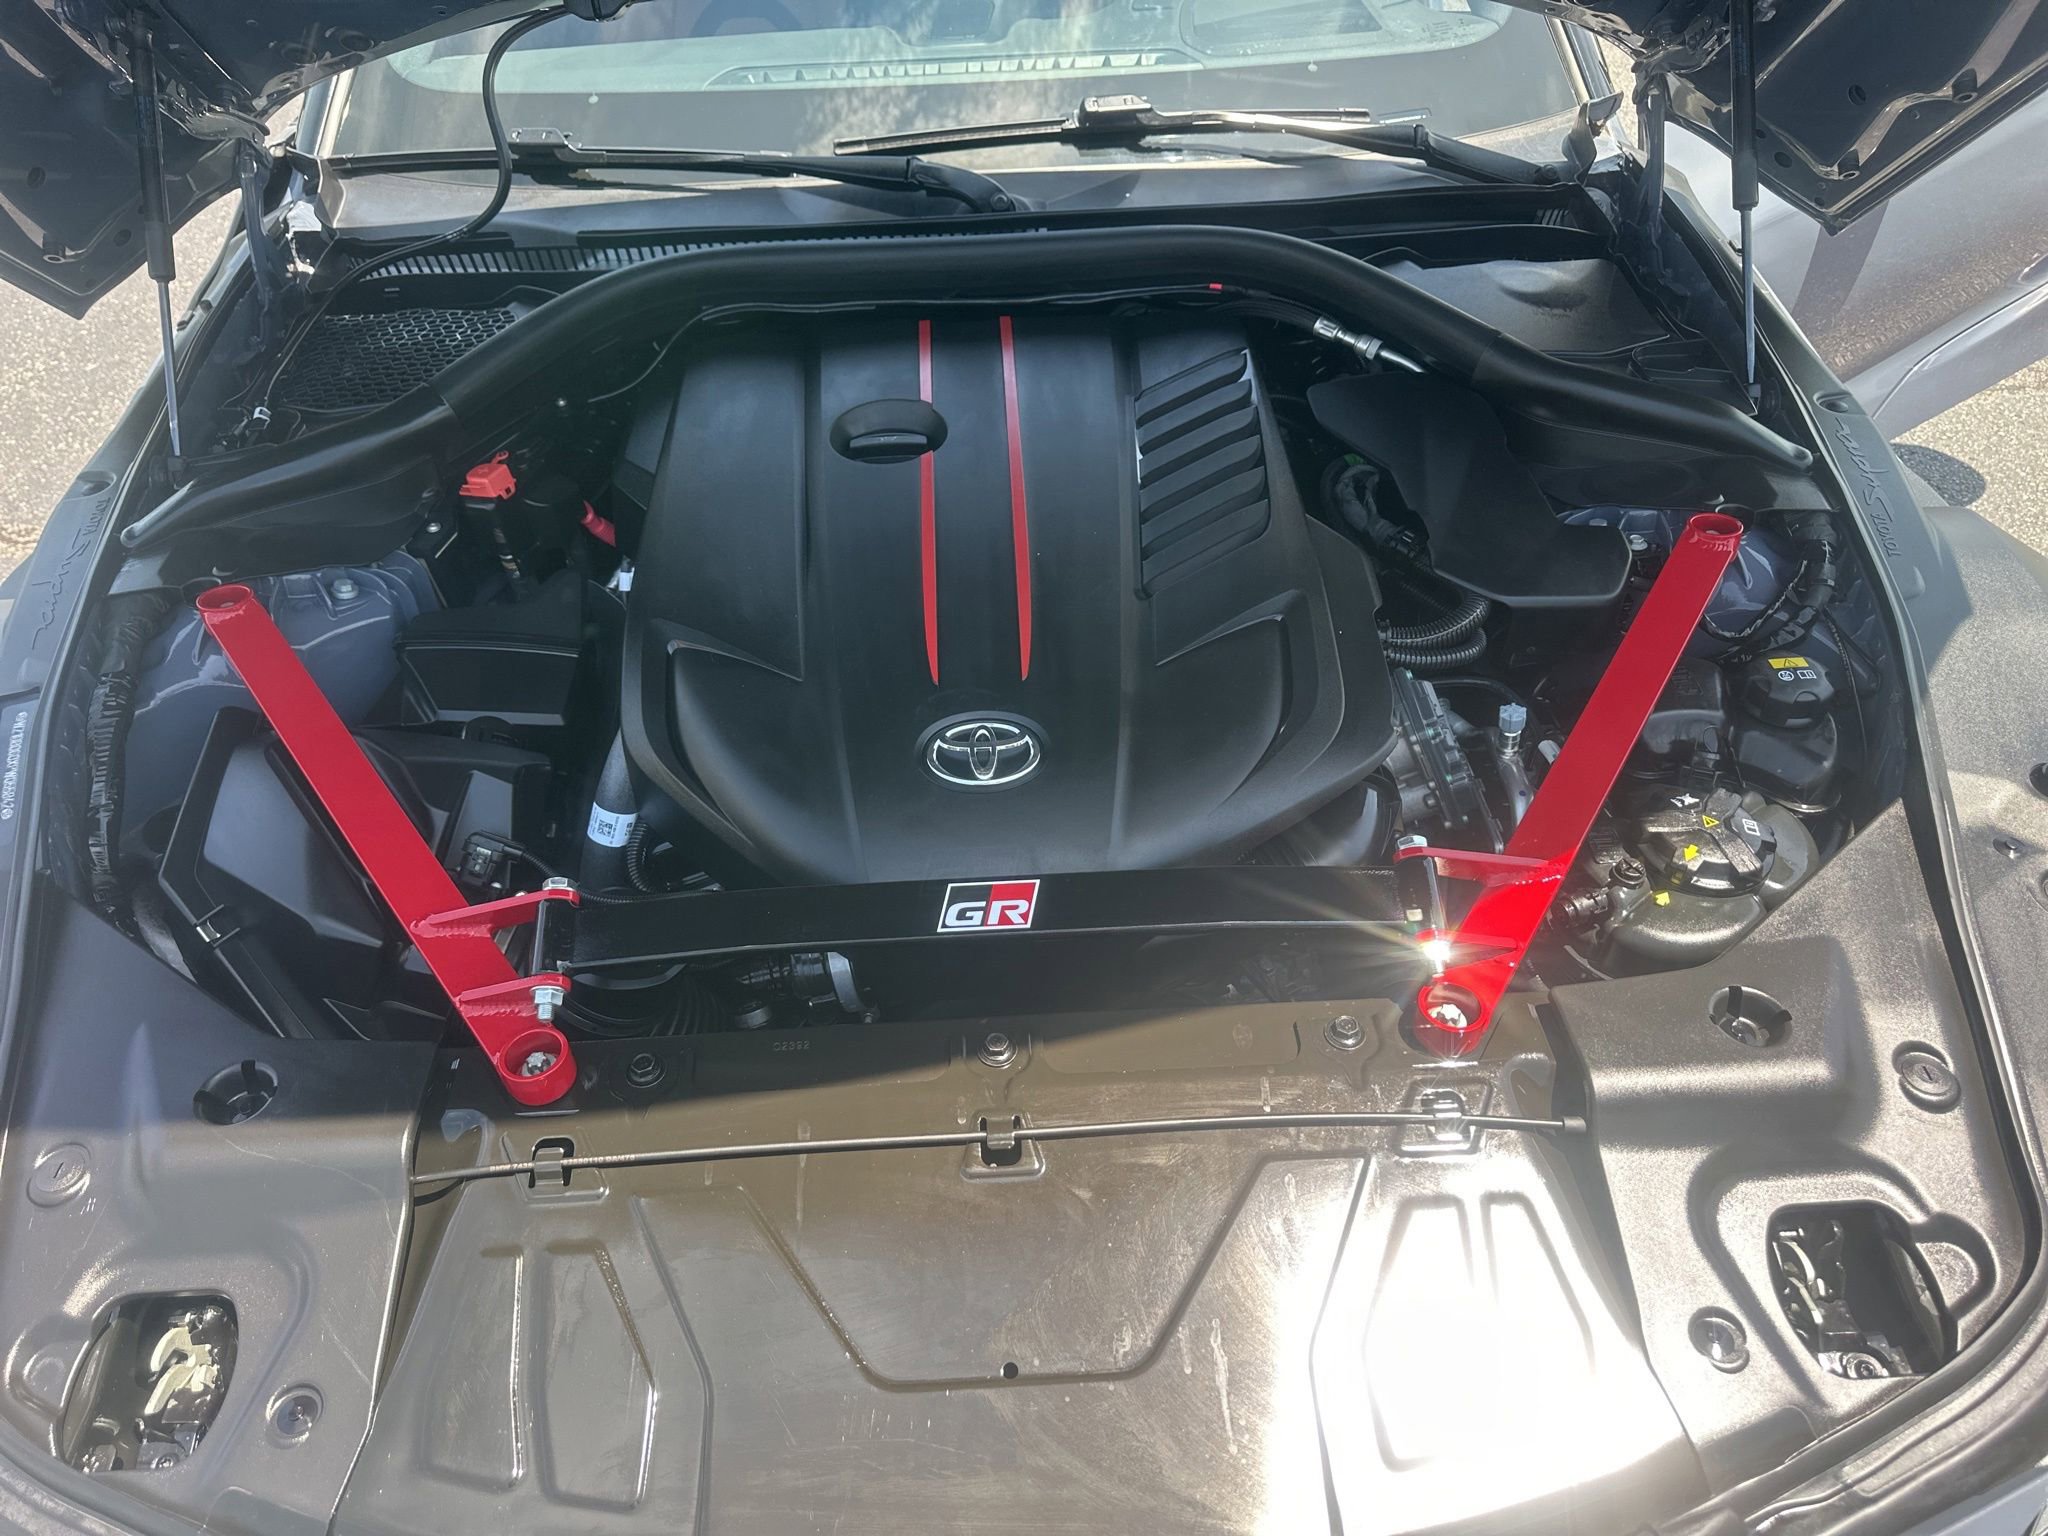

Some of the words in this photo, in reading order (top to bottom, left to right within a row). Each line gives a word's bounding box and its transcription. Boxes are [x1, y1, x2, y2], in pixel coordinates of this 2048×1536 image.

[83, 497, 111, 536] TOYOTA
[1870, 513, 1902, 557] TOYOTA
[944, 899, 1030, 927] GR
